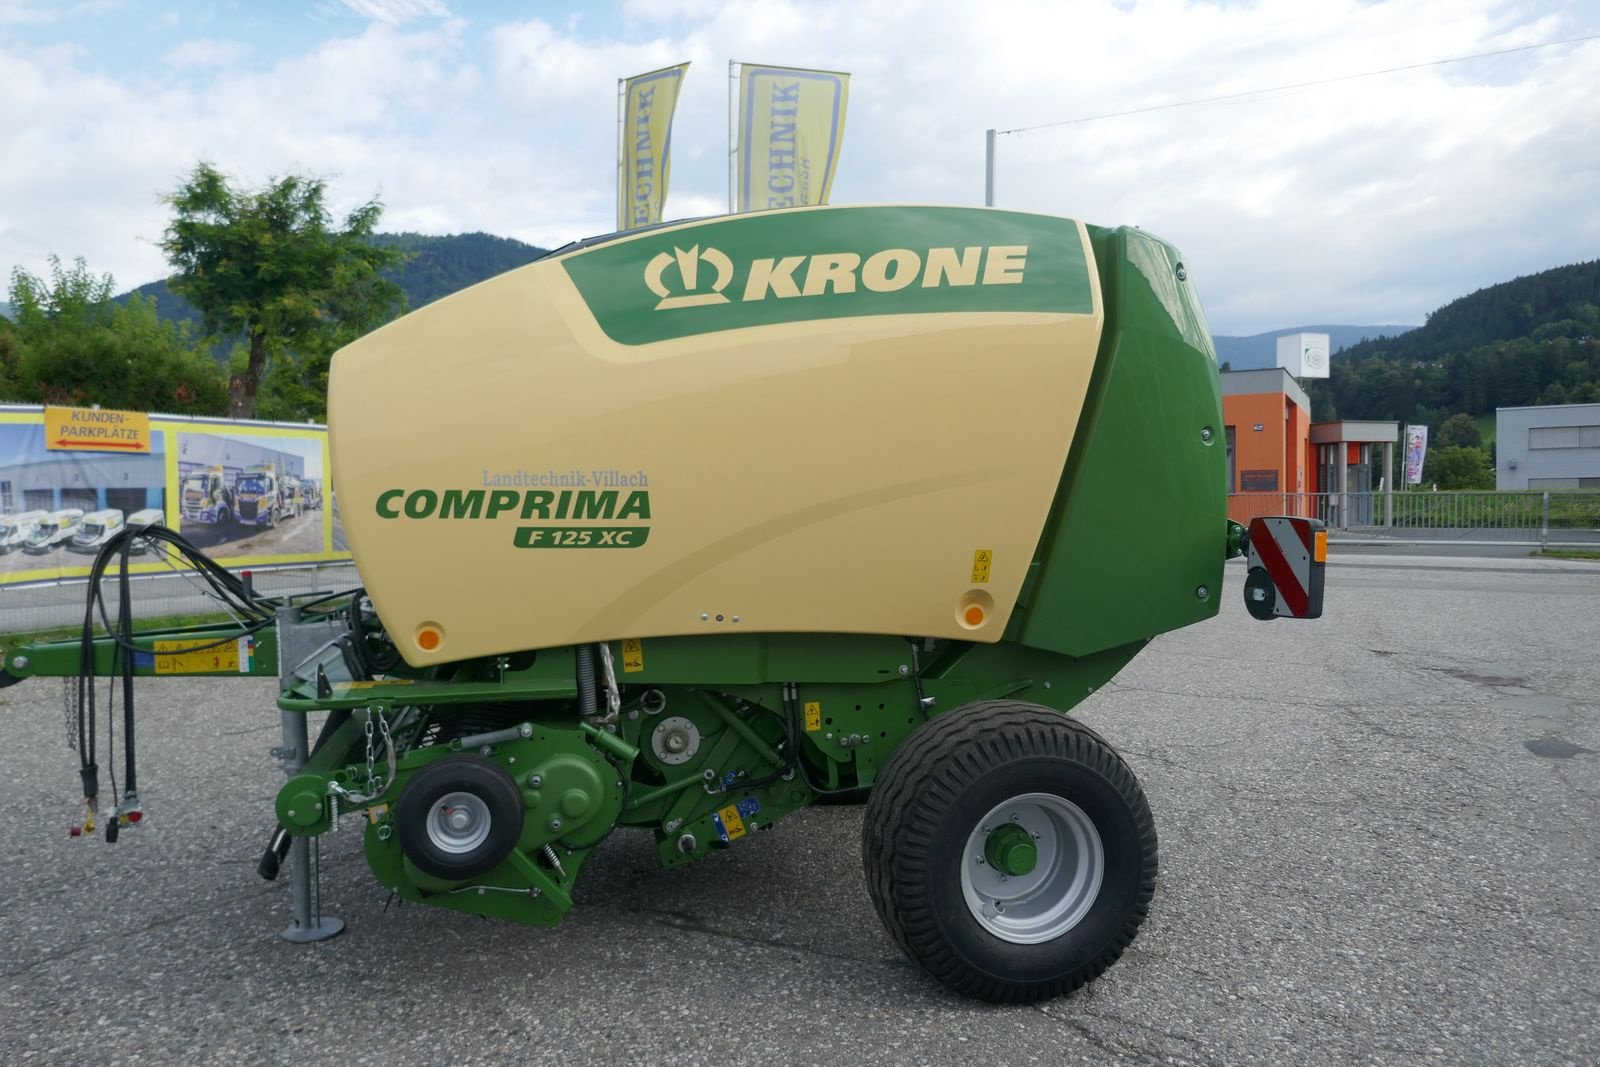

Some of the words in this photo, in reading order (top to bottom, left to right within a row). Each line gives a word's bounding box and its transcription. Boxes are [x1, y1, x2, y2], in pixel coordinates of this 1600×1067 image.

[742, 245, 1028, 302] KRONE
[71, 410, 130, 424] KUNDEN-
[60, 425, 140, 440] PARKPLÄTZE
[375, 489, 652, 520] COMPRIMA
[528, 530, 545, 545] F
[551, 530, 593, 545] 125
[597, 530, 634, 545] XC
